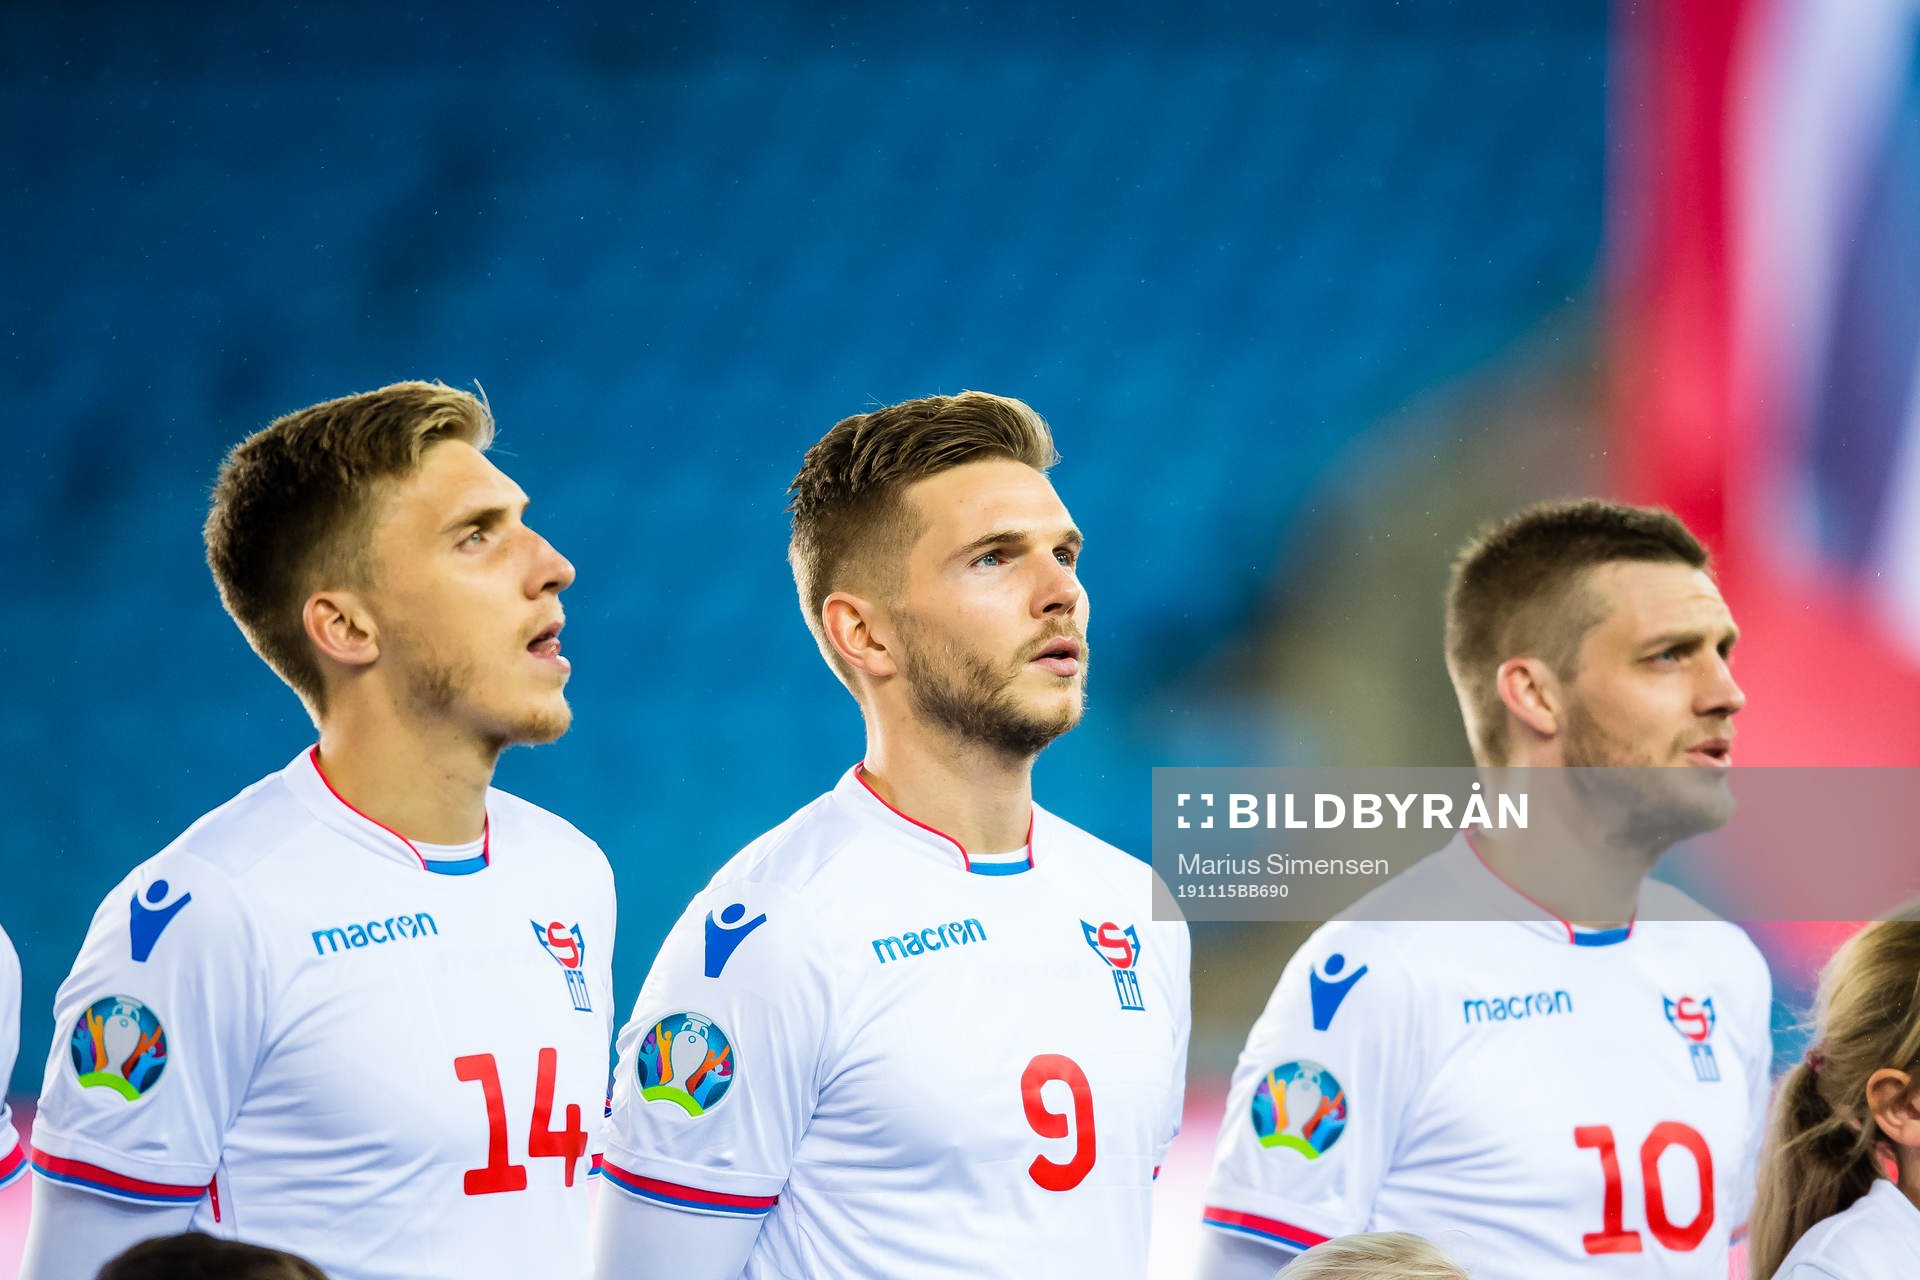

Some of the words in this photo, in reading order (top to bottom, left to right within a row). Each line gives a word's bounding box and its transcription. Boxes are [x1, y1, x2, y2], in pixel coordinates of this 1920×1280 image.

[312, 912, 438, 955] macron
[872, 918, 987, 964] macron
[1463, 990, 1573, 1024] macron
[454, 1047, 588, 1196] 14
[1020, 1054, 1096, 1192] 9
[1574, 1121, 1714, 1255] 10
